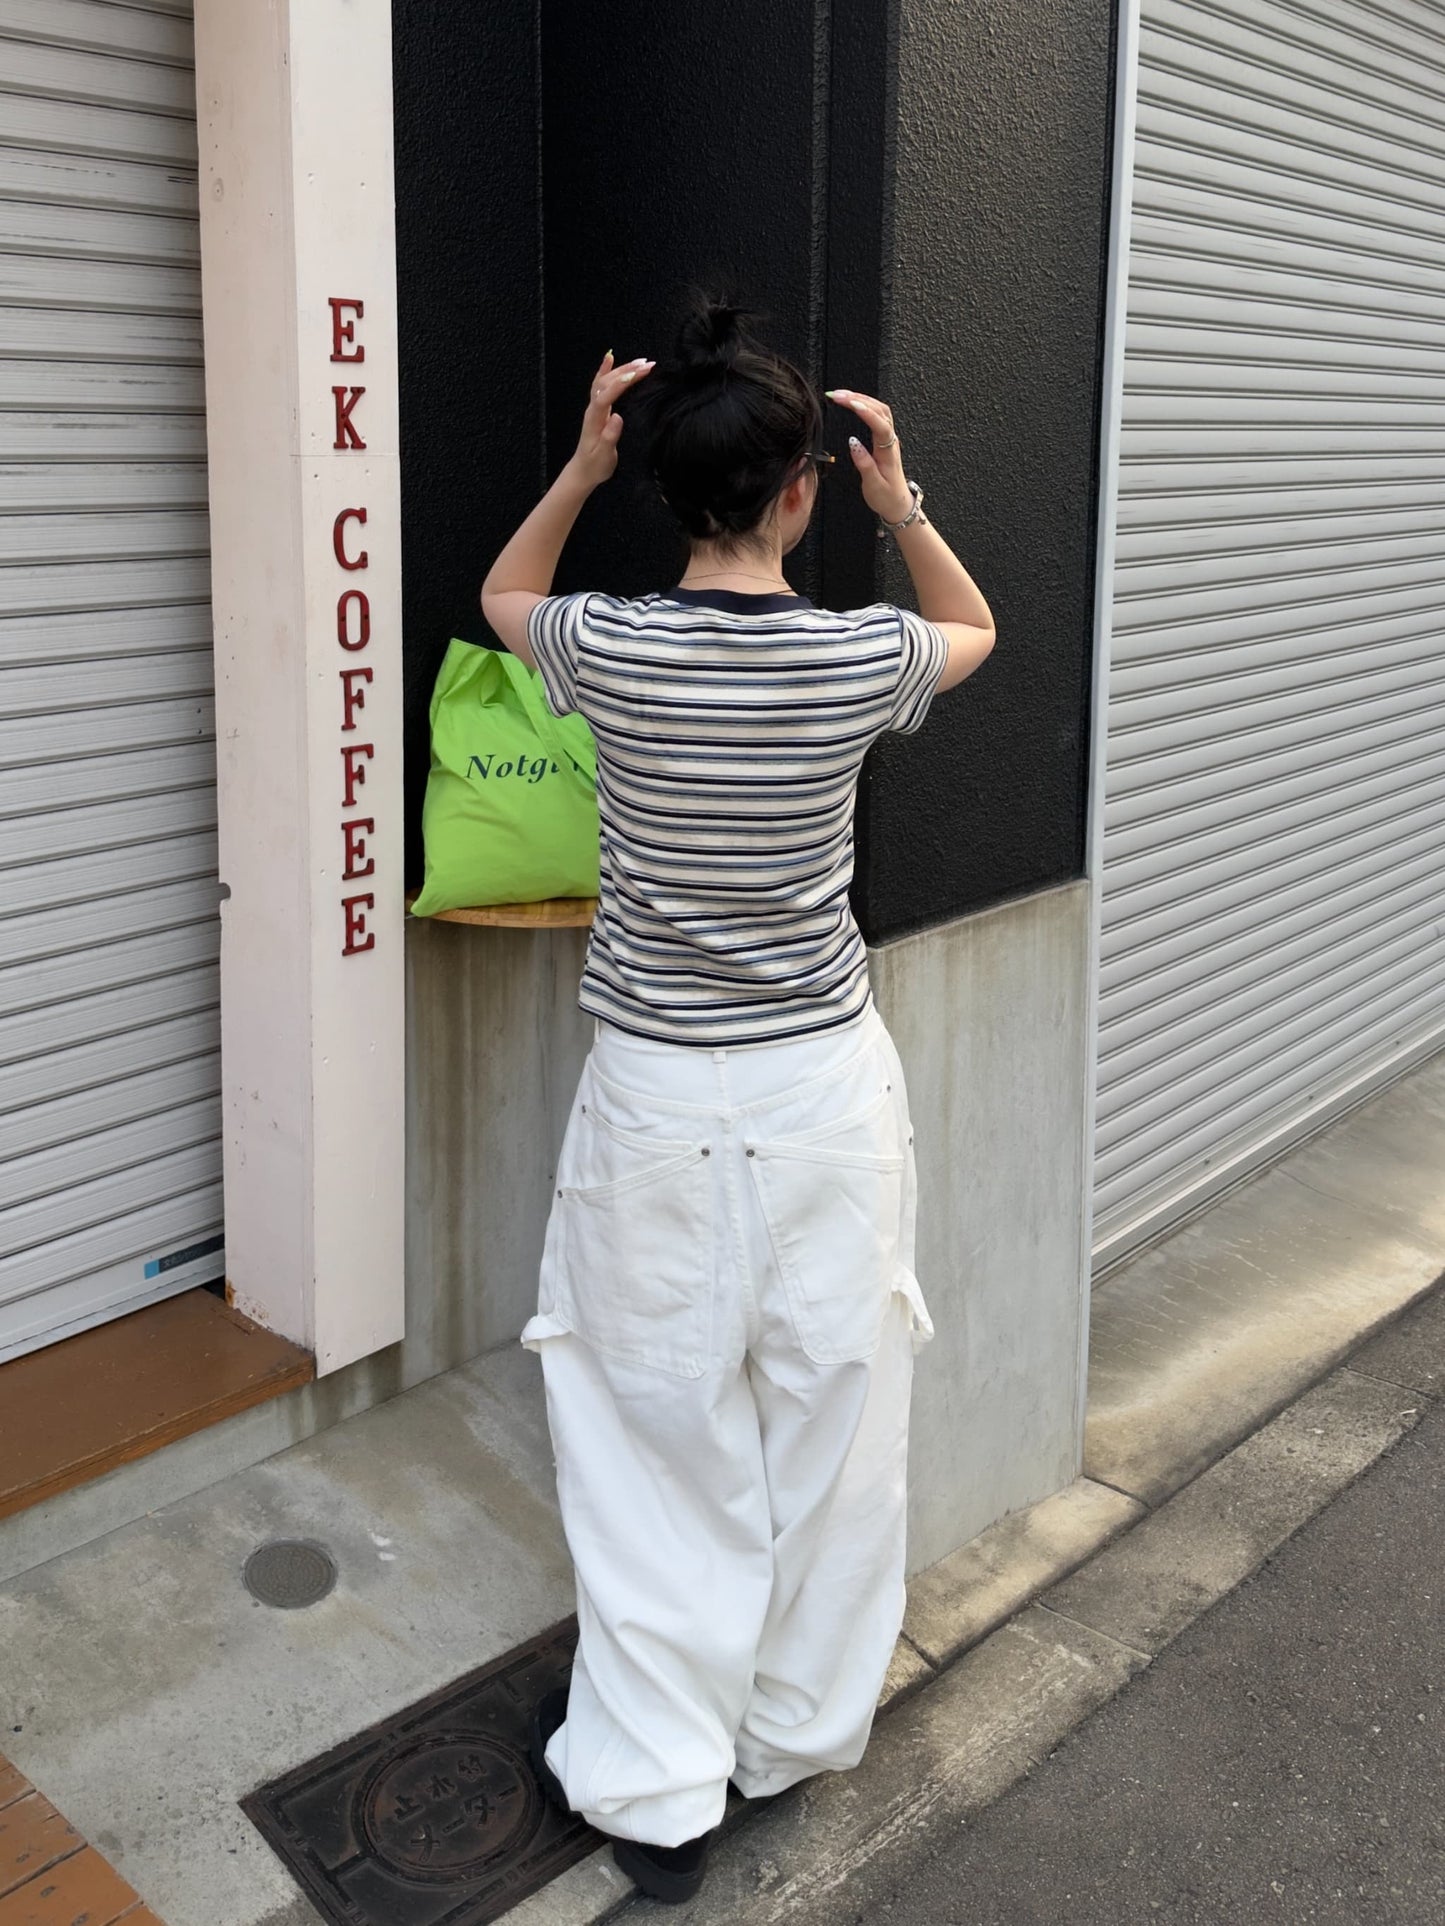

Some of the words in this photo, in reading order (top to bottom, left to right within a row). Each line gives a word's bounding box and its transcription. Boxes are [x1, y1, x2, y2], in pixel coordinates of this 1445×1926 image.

[328, 297, 366, 450] EK
[333, 508, 375, 956] COFFEE
[464, 754, 579, 784] Notg
[410, 1786, 519, 1862] メーター
